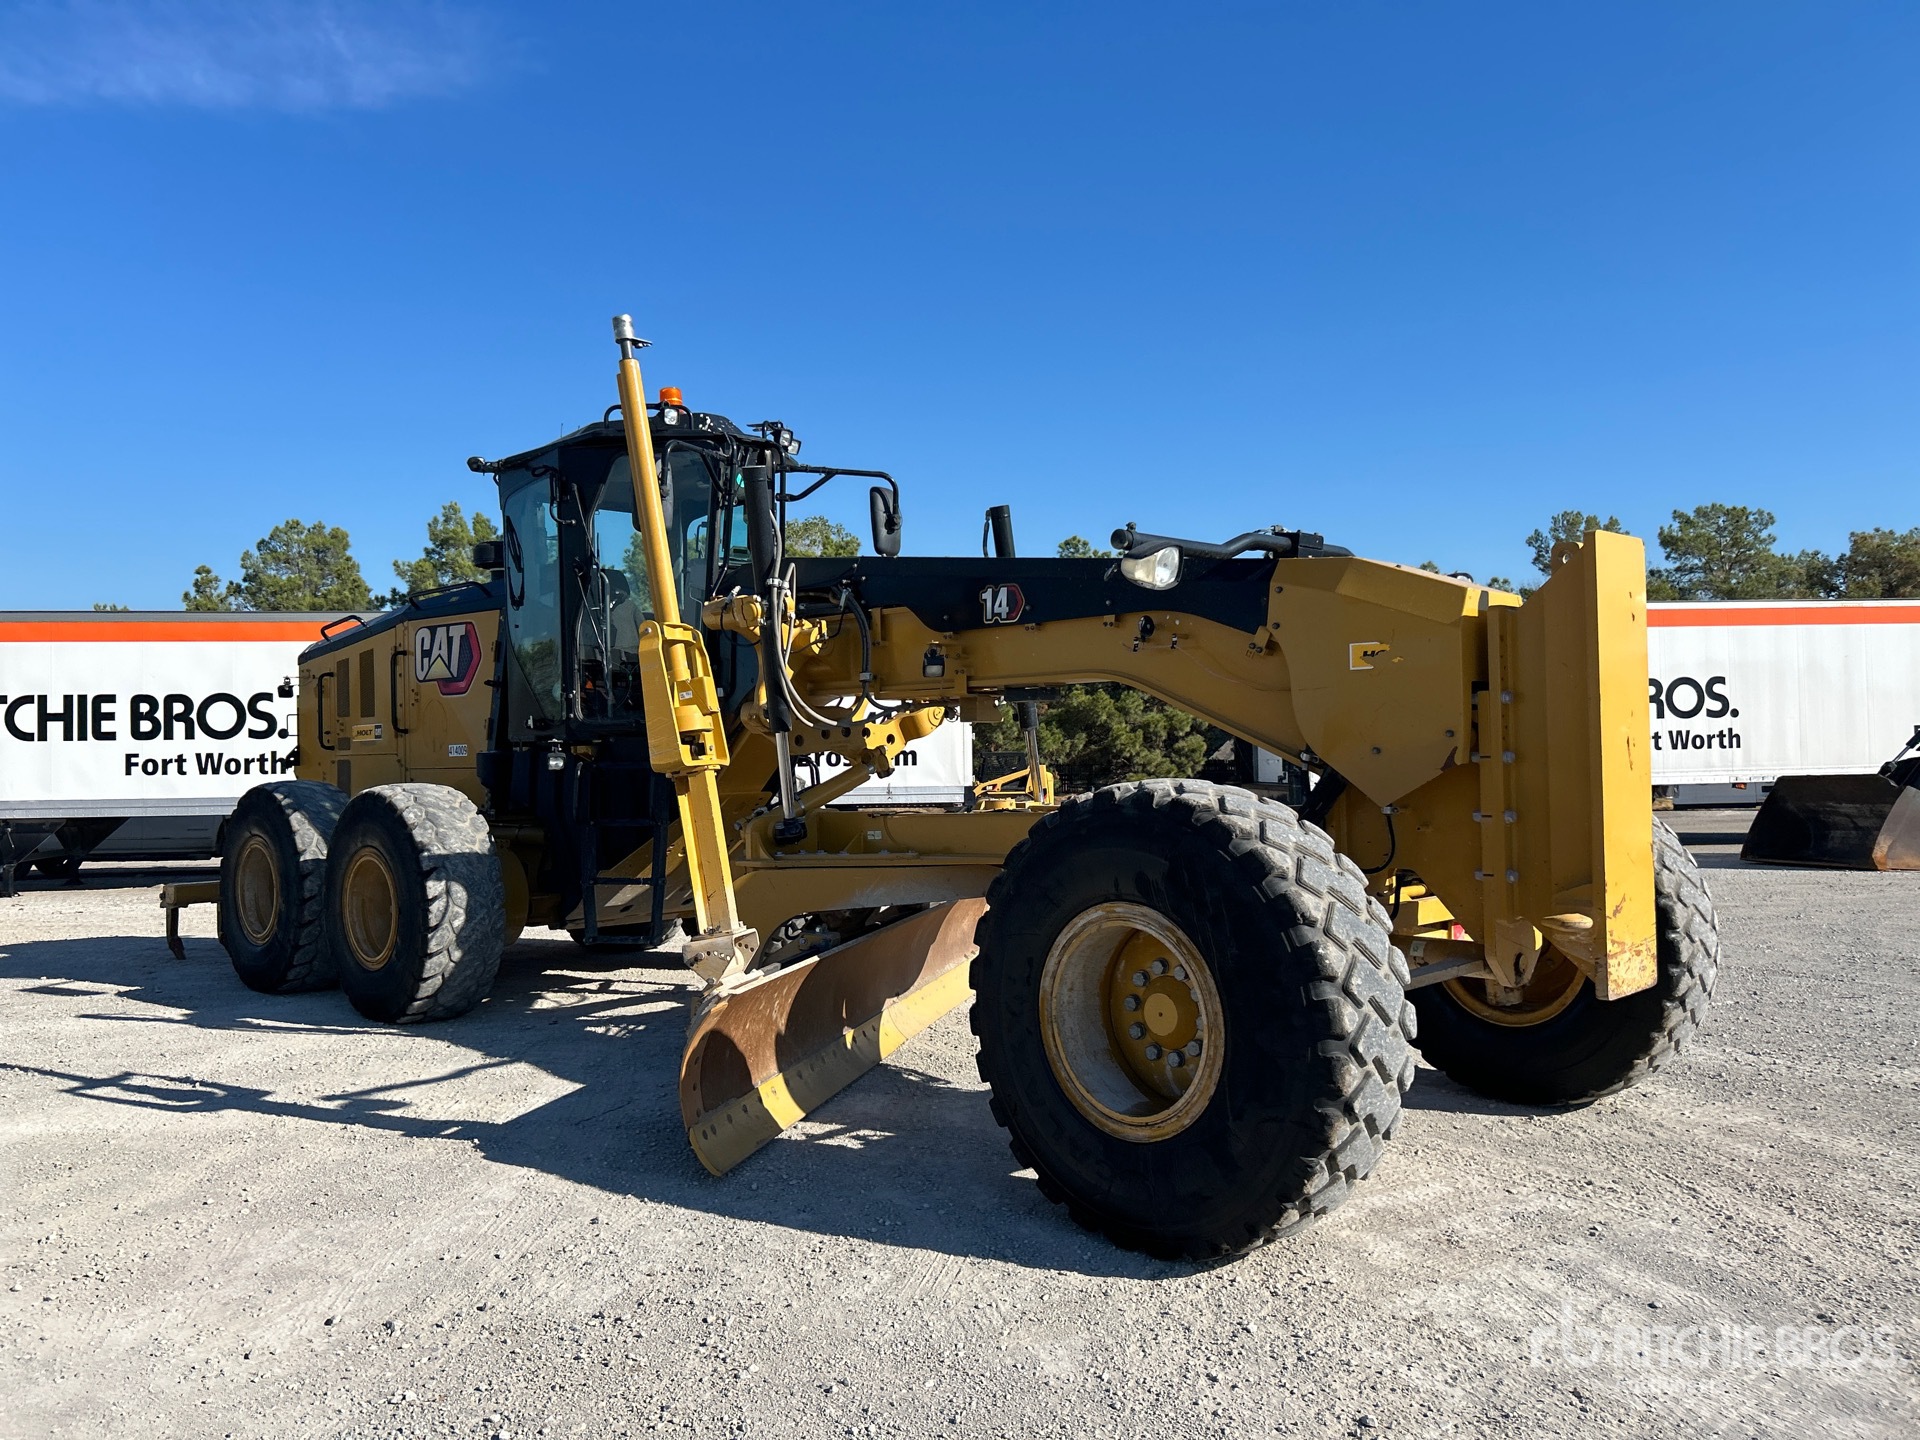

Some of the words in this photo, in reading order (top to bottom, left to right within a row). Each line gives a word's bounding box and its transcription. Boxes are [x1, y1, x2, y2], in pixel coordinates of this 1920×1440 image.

[982, 587, 1009, 619] 14
[416, 624, 466, 681] CAT
[0, 694, 116, 741] CHIE
[130, 692, 289, 740] BROS.
[357, 729, 373, 737] HOLT
[1668, 728, 1741, 750] Worth
[125, 753, 187, 775] Fort
[195, 751, 287, 775] Worth
